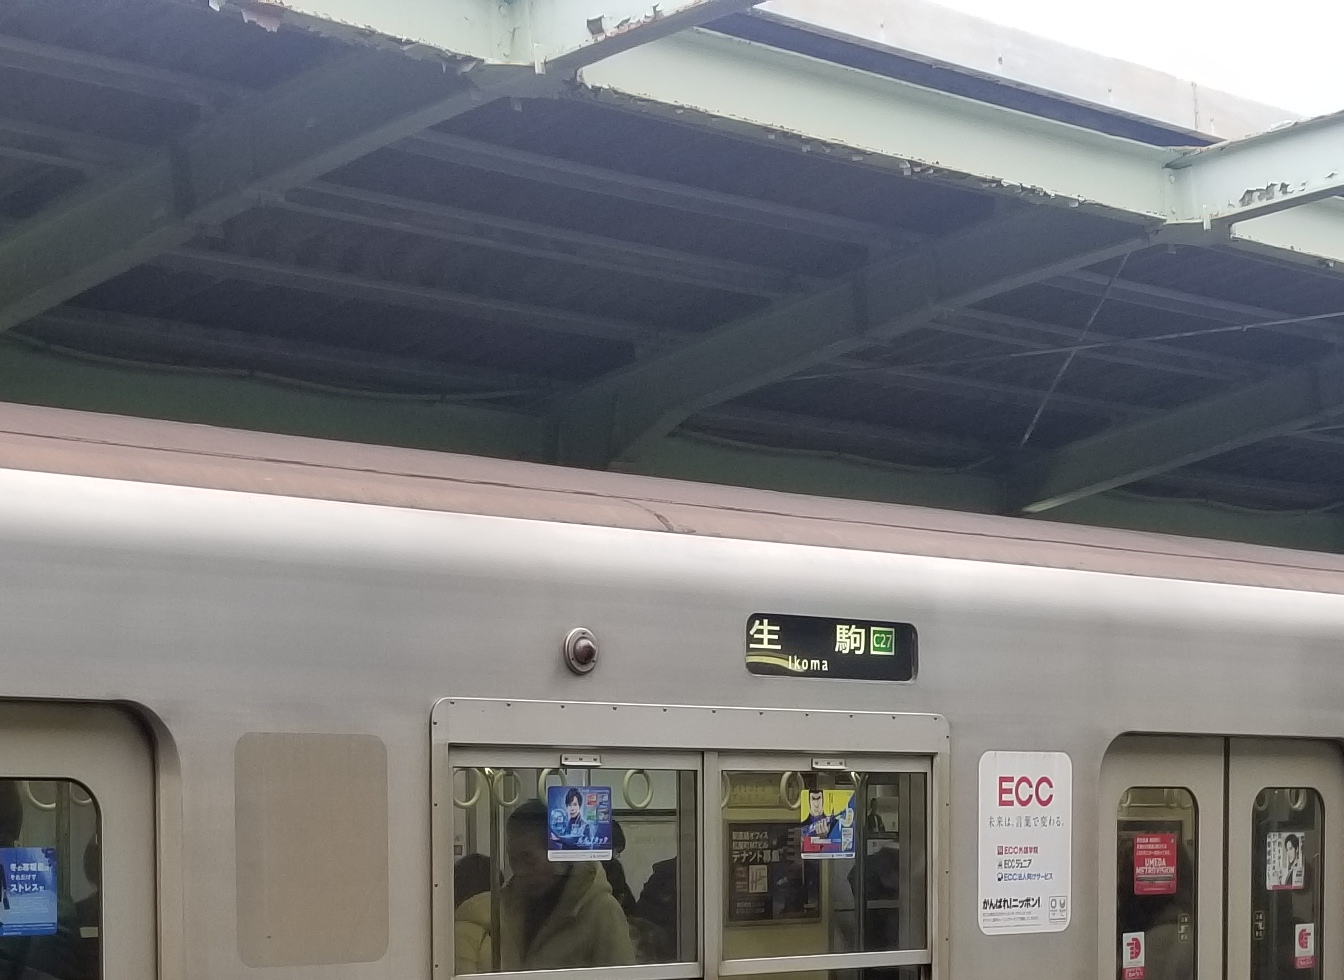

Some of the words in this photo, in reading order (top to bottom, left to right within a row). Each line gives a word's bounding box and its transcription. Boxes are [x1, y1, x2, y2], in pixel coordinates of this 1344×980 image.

[873, 633, 892, 648] C27
[788, 655, 829, 671] Ikoma
[998, 775, 1054, 807] ECC
